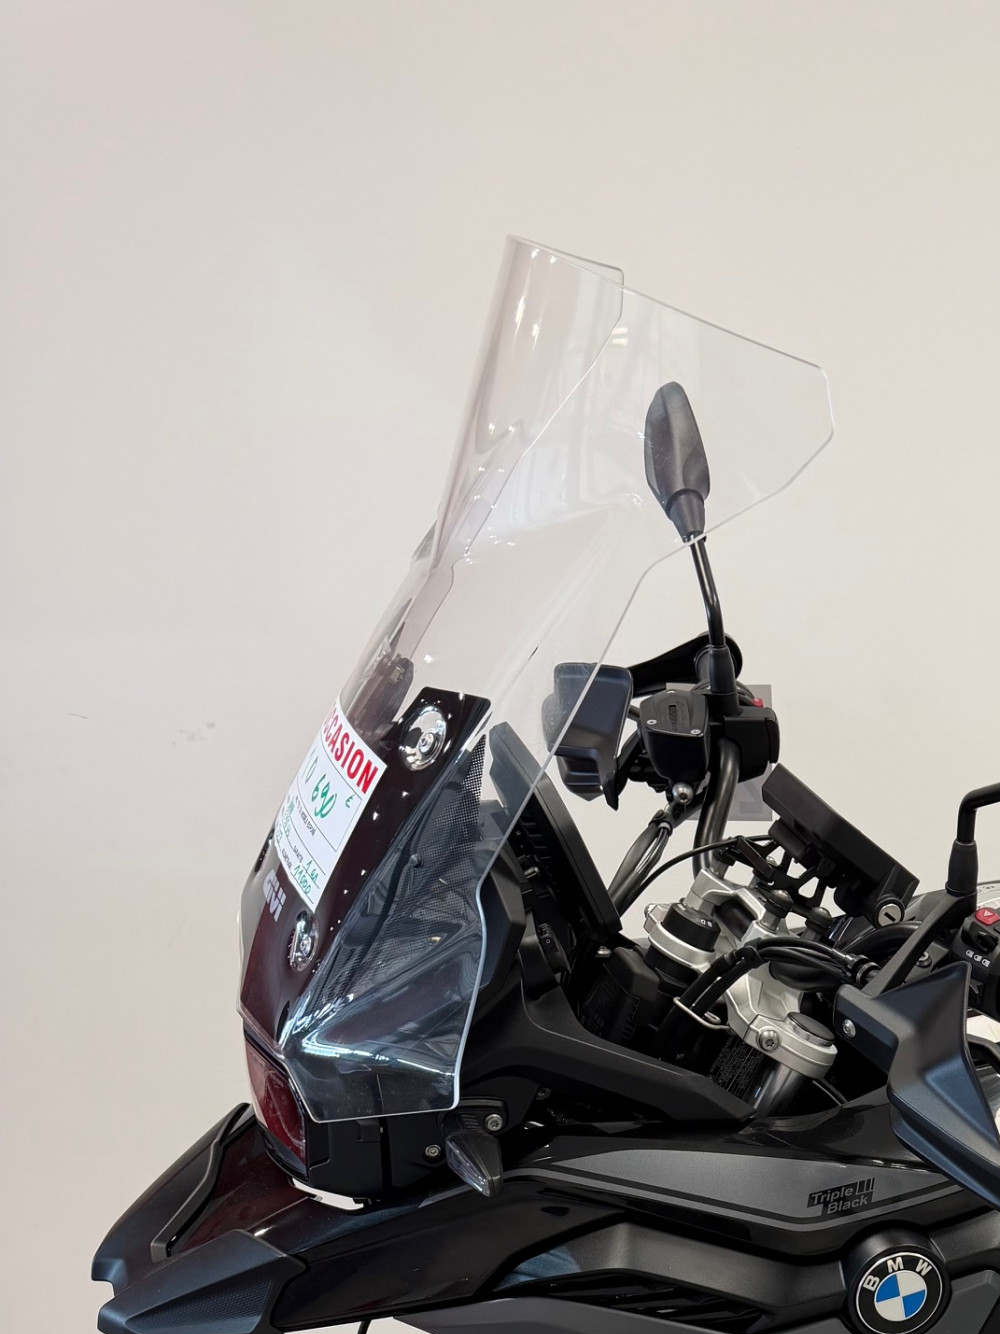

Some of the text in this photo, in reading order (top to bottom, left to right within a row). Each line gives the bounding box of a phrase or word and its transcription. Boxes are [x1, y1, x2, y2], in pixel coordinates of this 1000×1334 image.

[811, 1185, 854, 1205] Triple
[827, 1194, 869, 1215] Black
[862, 1256, 933, 1292] BMW
